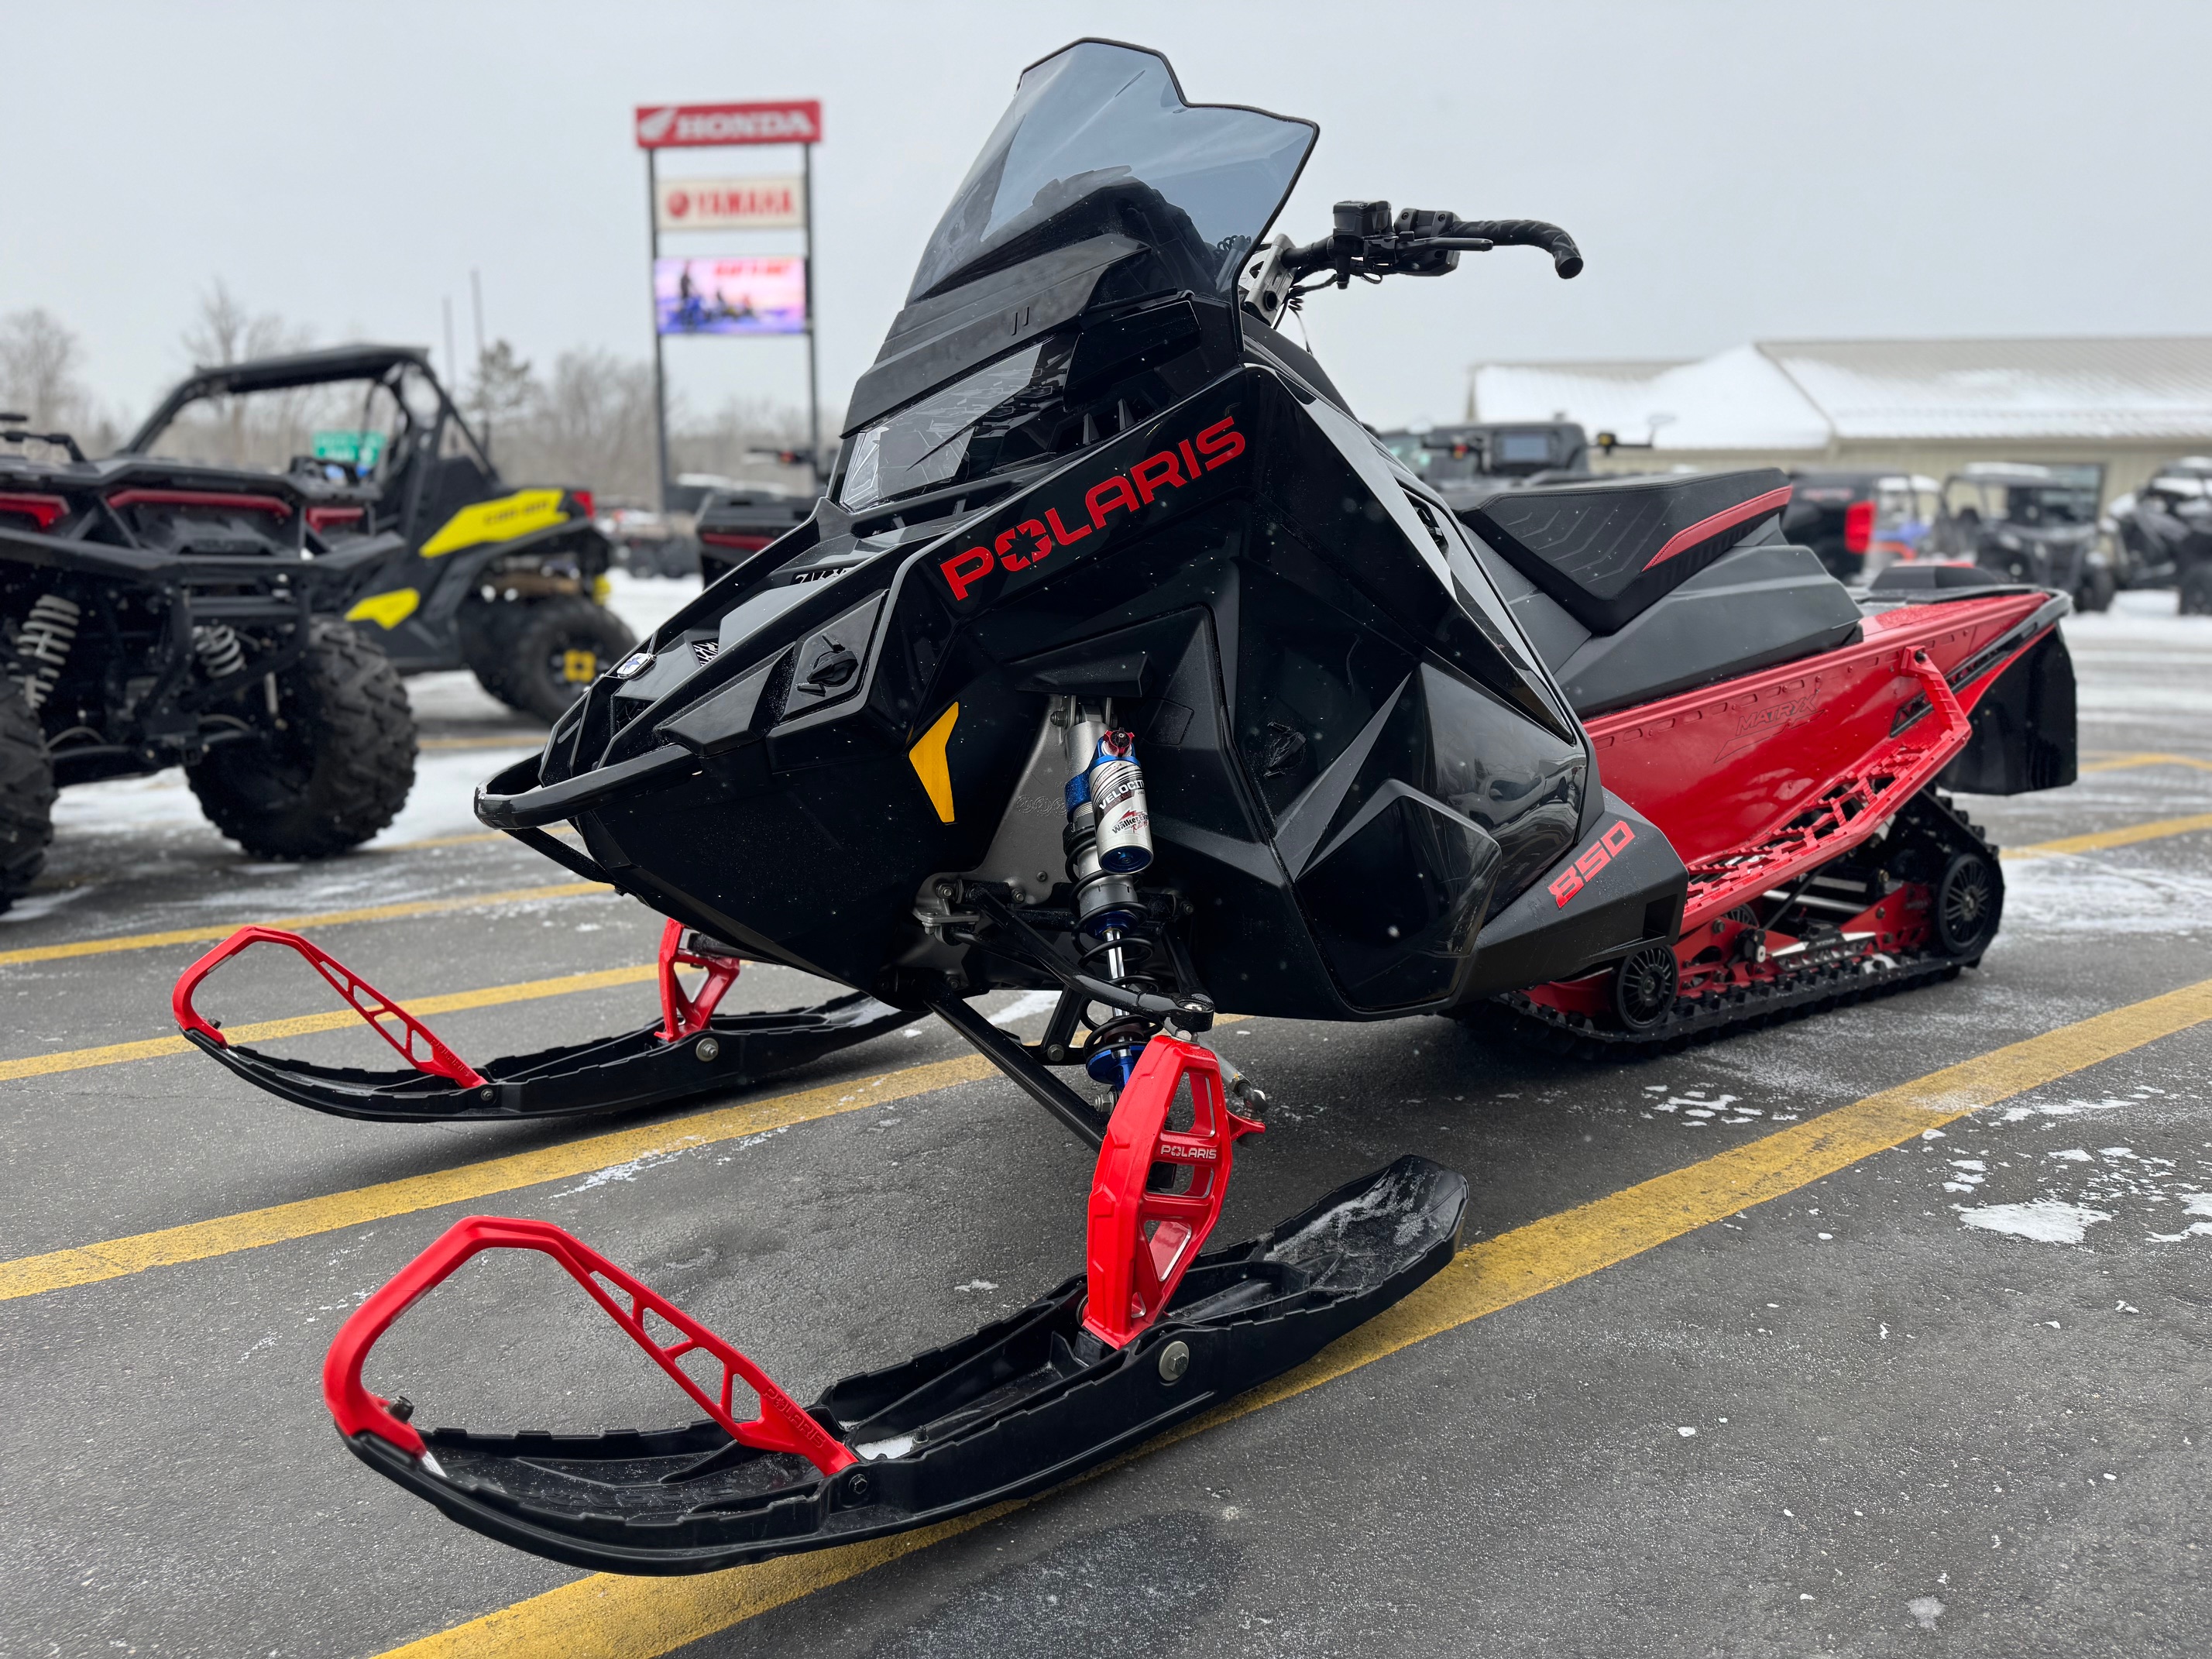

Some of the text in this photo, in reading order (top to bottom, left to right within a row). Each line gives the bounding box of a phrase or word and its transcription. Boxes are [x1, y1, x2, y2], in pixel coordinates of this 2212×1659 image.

[675, 110, 813, 140] HONDA
[698, 189, 793, 216] YAMAHA
[939, 416, 1245, 600] POLARIS
[1736, 692, 1818, 737] MATRYX
[1099, 779, 1145, 810] VELOCIT
[1547, 820, 1635, 908] 850
[1160, 1144, 1217, 1159] POLARIS
[763, 1385, 826, 1448] POLARIS
